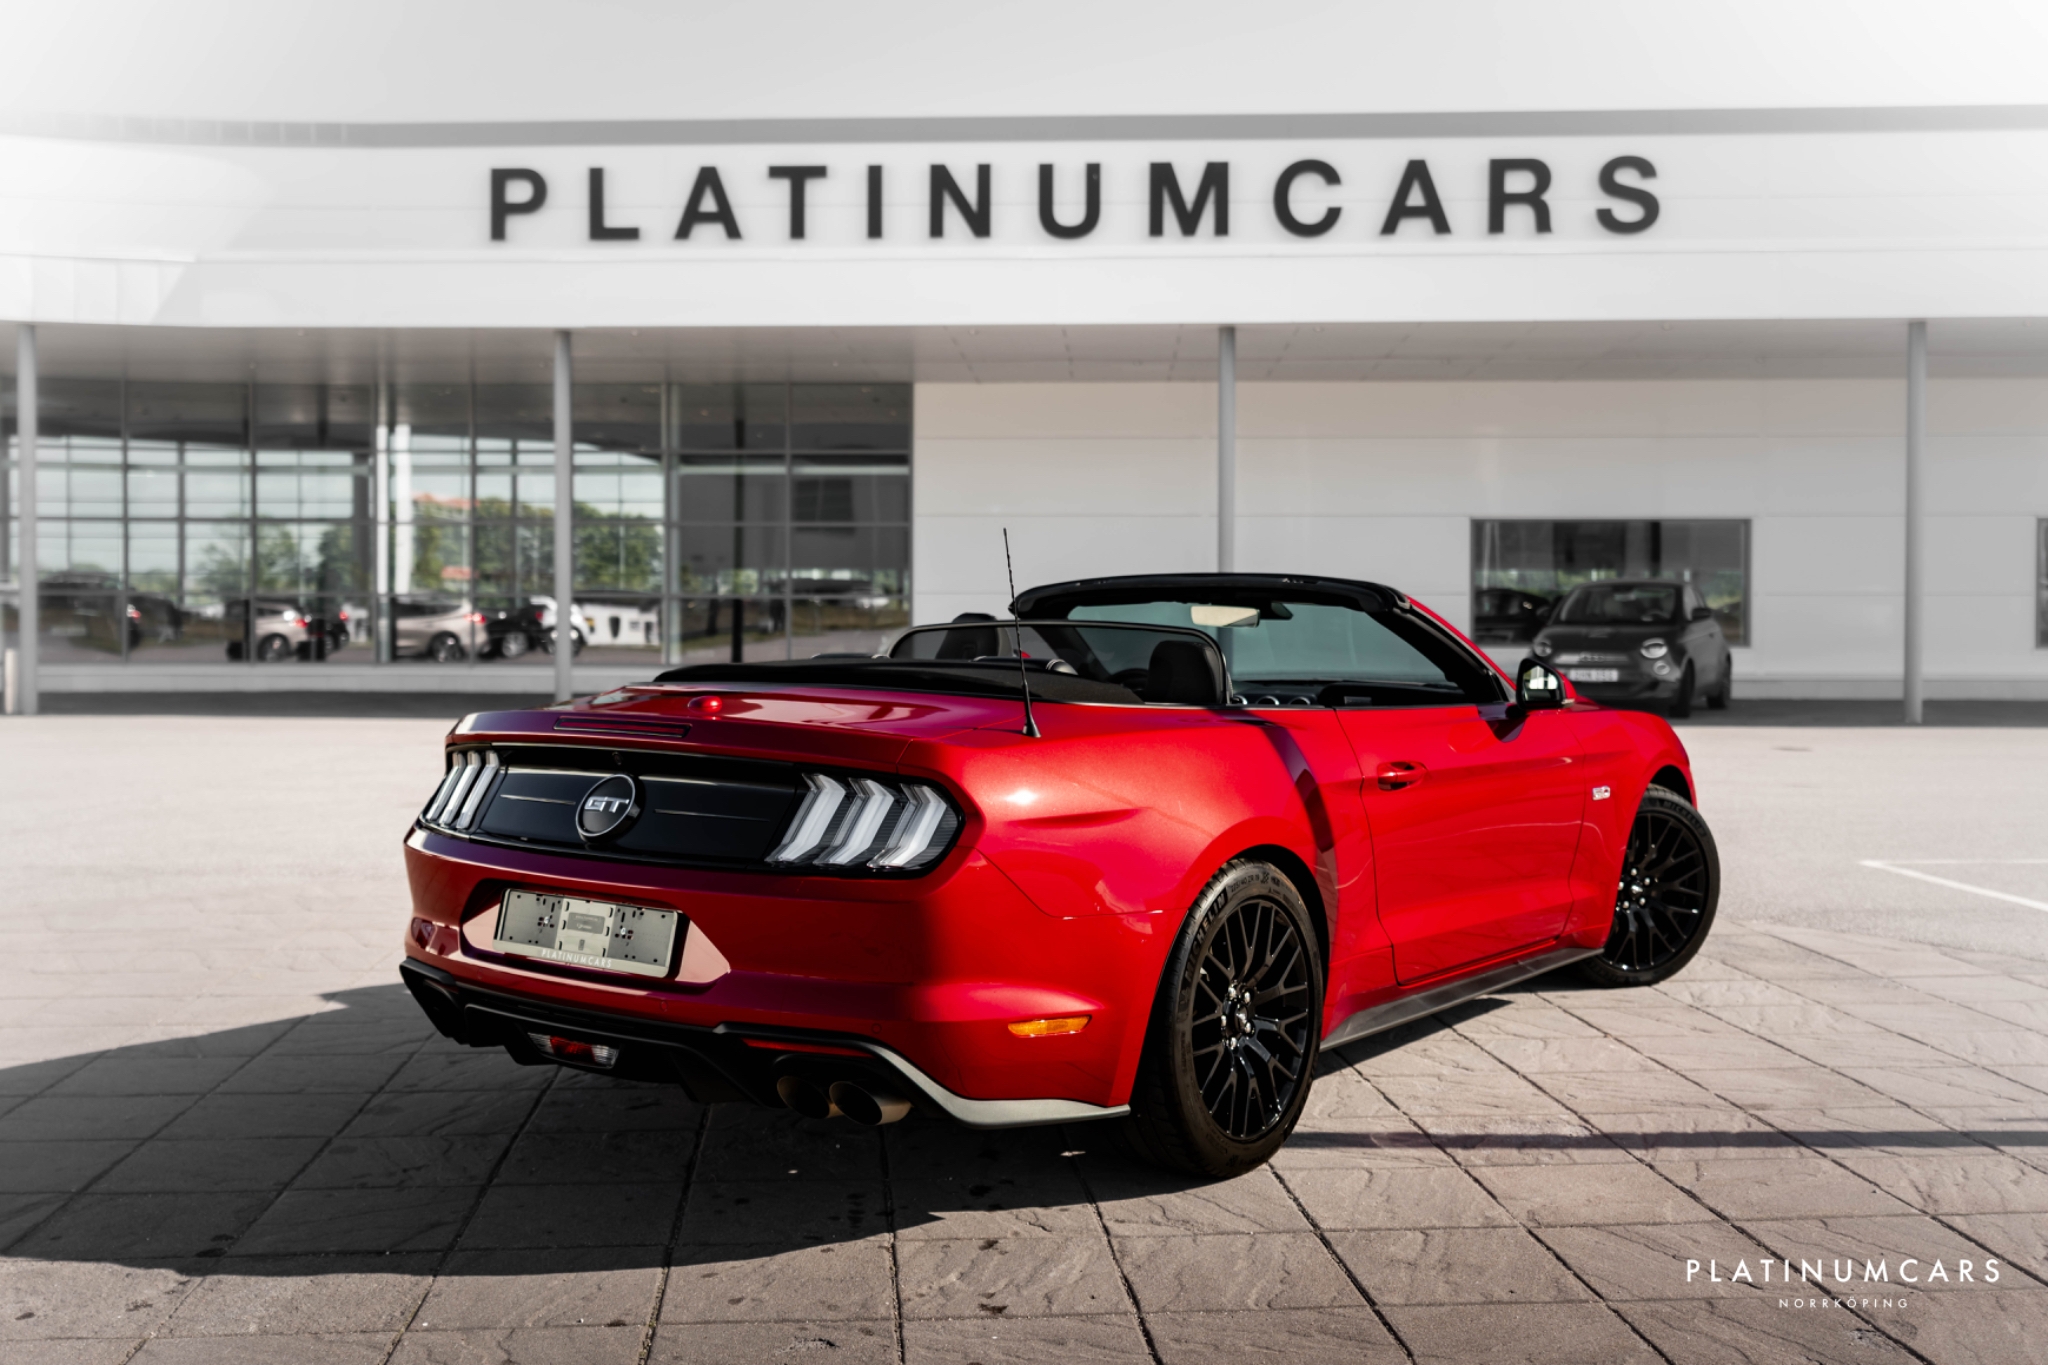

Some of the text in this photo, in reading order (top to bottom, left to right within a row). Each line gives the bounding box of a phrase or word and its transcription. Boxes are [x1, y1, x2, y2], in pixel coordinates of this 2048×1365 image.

[489, 155, 1662, 241] PLATINUMCARS
[584, 796, 630, 813] GT
[541, 949, 612, 968] PLATINUMCARS
[1185, 891, 1226, 983] MICHELIN
